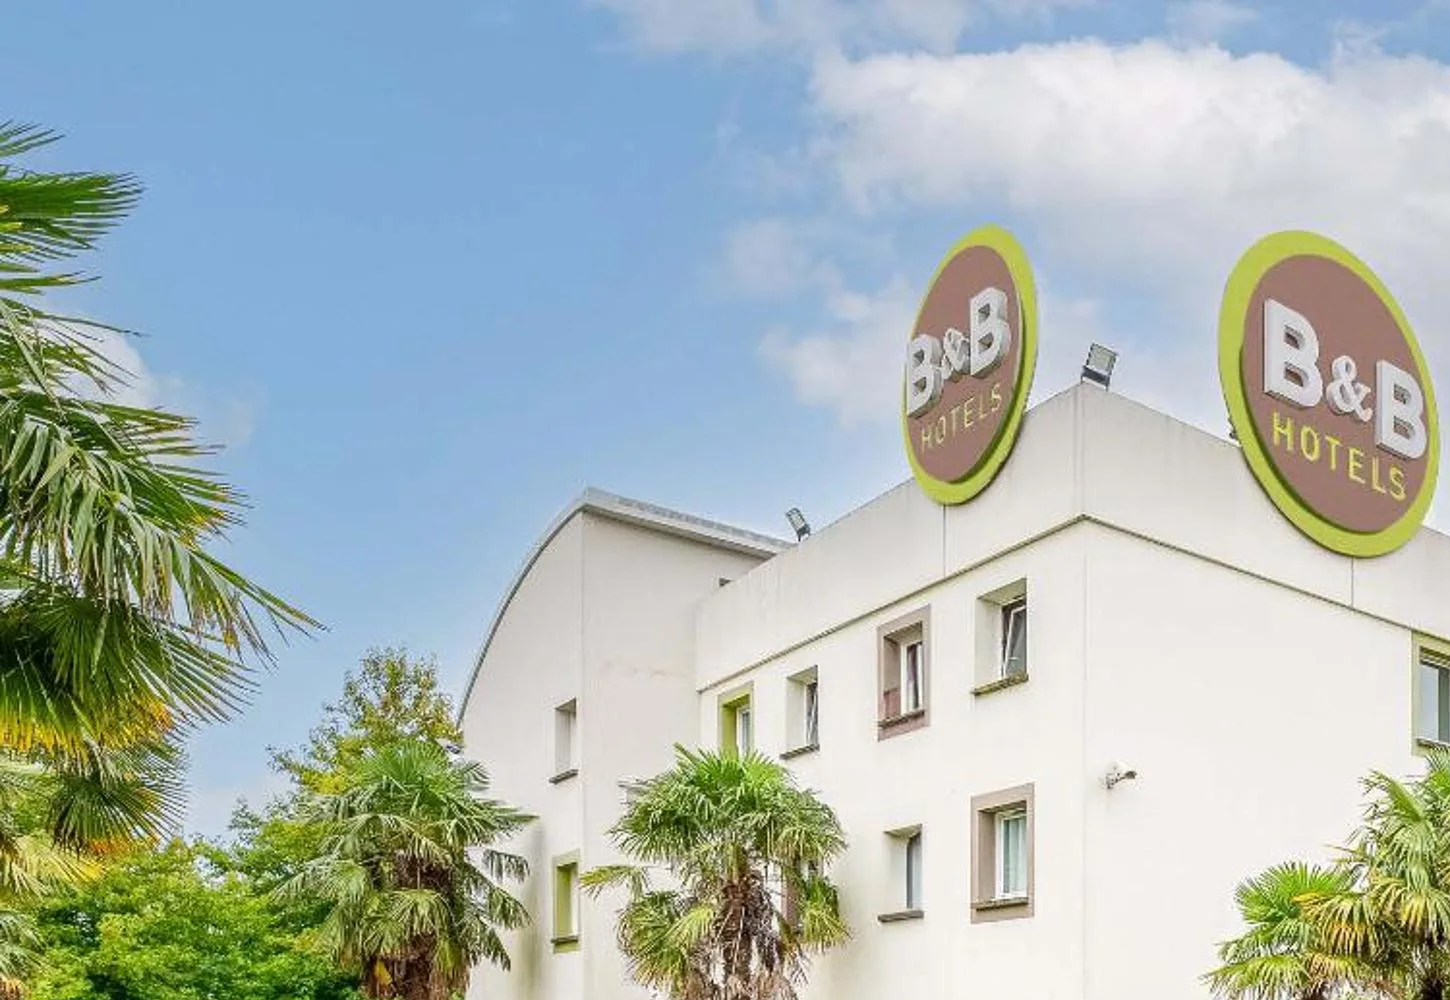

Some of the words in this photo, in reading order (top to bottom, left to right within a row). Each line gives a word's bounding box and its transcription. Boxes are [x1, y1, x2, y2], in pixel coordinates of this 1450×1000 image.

[907, 287, 1011, 418] B&B
[1264, 298, 1427, 460] B&B
[921, 383, 1002, 452] HOTELS
[1271, 411, 1407, 501] HOTELS
